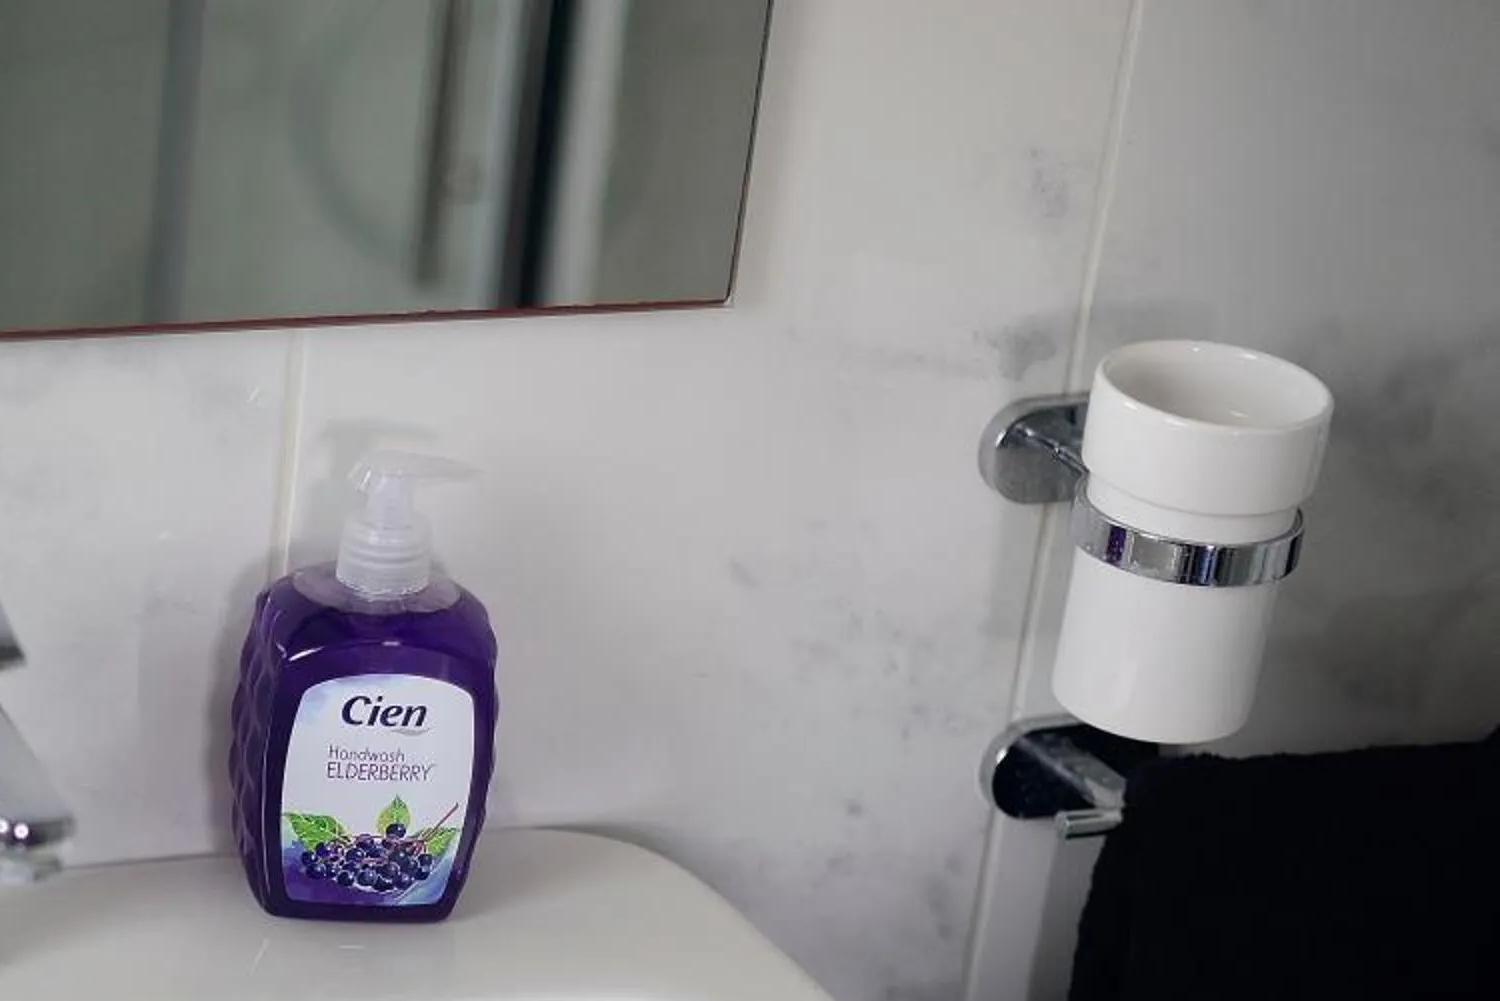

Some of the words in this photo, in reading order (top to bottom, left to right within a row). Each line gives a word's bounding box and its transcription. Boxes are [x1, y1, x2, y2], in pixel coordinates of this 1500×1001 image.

[341, 695, 427, 727] Cien
[328, 744, 405, 763] Handwash
[327, 762, 432, 782] ELDERBERRY
